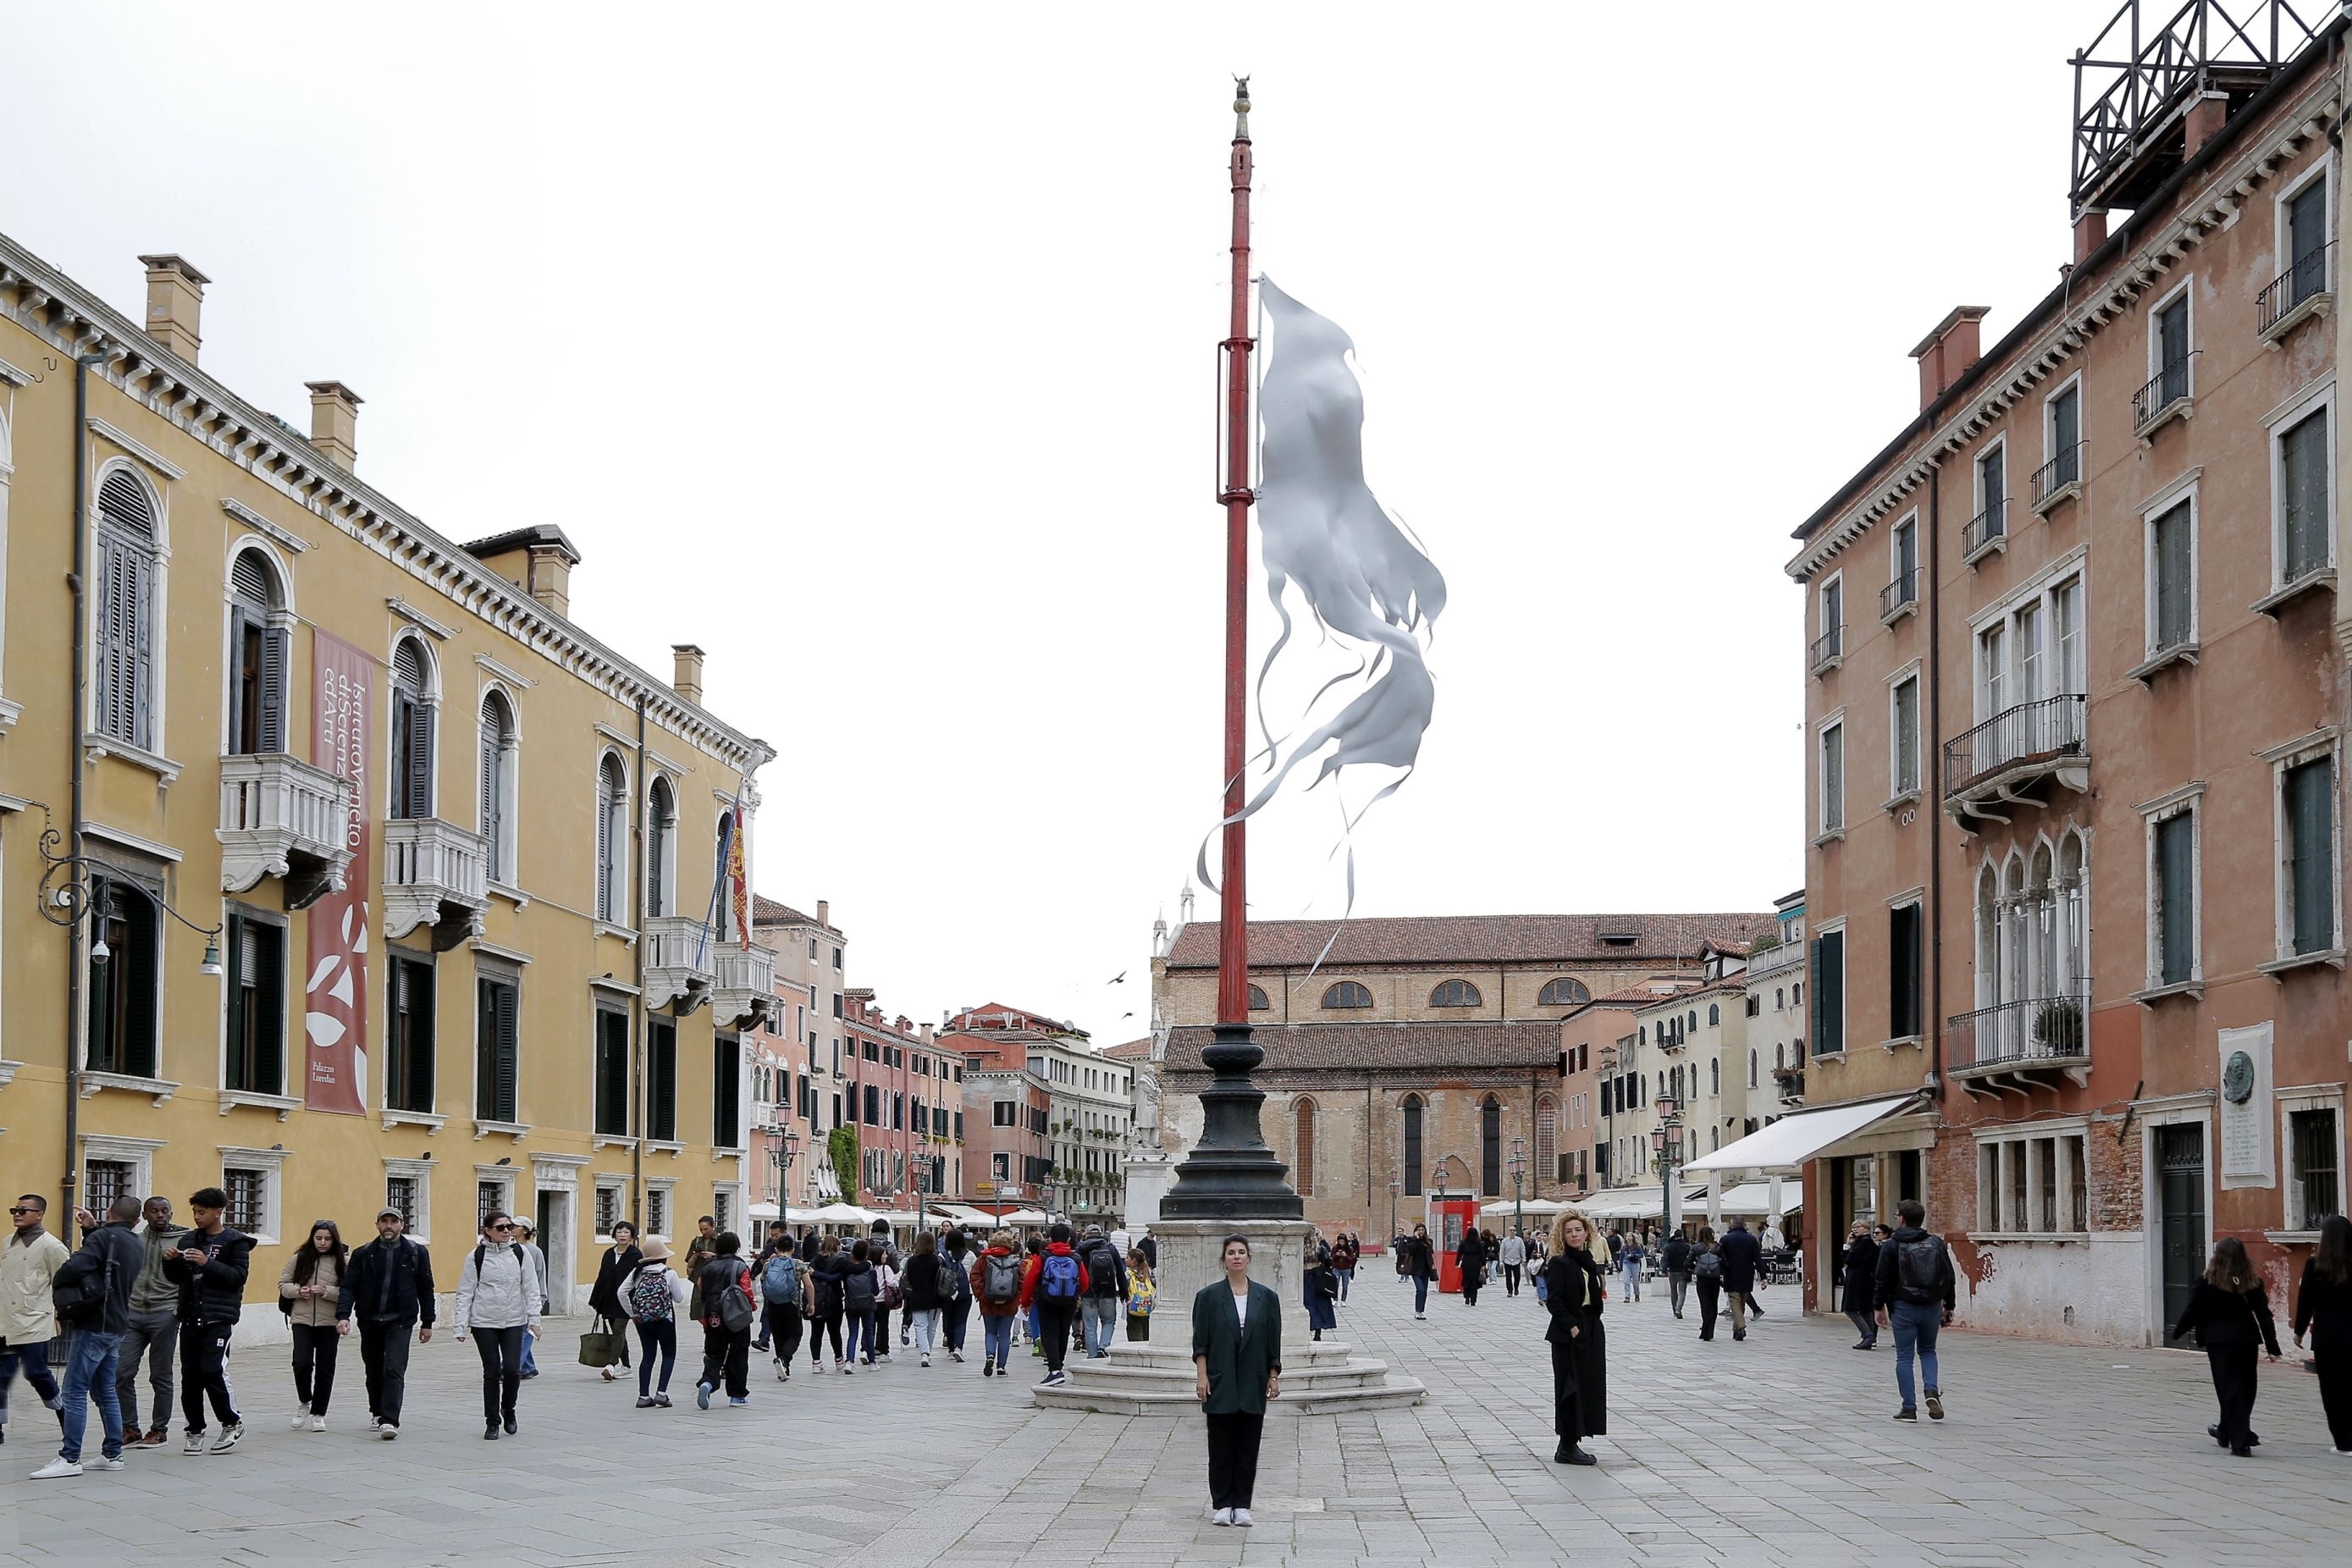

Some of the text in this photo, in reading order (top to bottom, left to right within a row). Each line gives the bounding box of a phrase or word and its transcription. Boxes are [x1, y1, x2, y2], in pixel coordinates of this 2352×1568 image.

[324, 667, 338, 745] edArti
[336, 674, 352, 777] diScienz
[313, 1061, 334, 1073] Palazzo
[313, 1072, 335, 1084] Loredan
